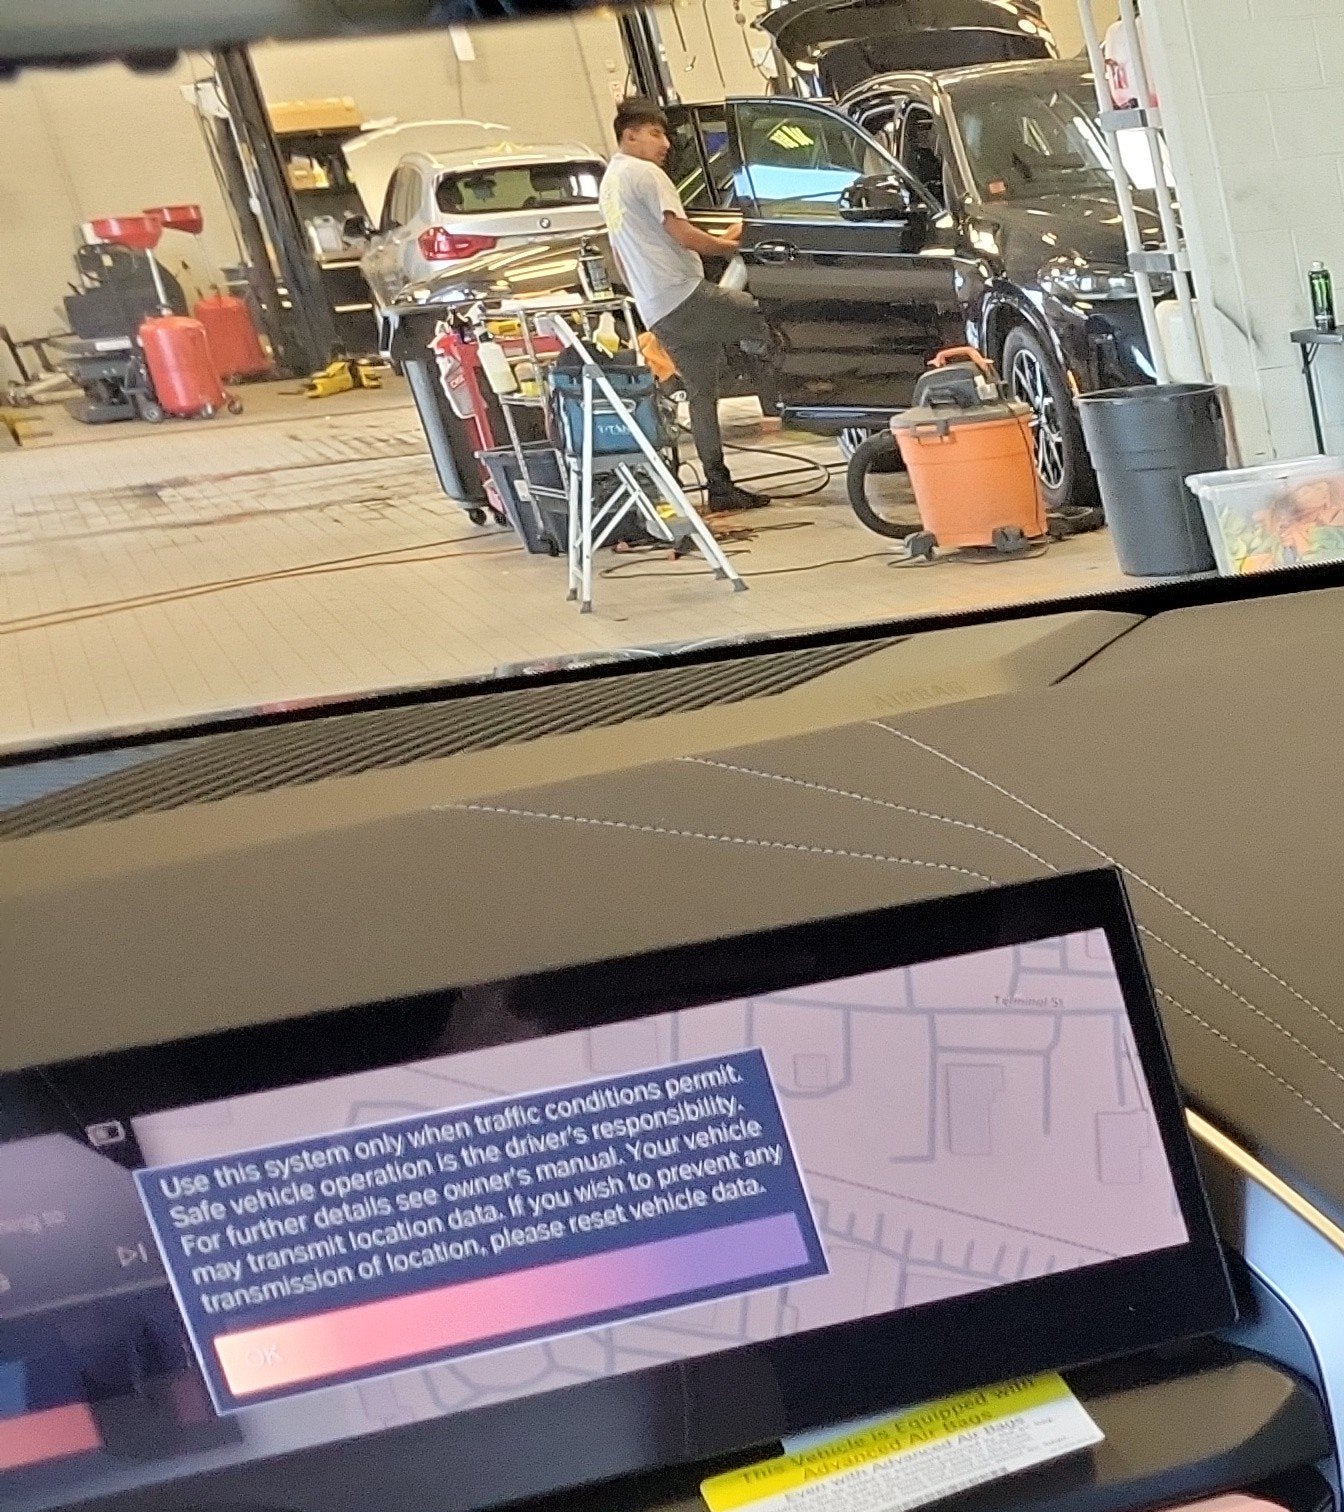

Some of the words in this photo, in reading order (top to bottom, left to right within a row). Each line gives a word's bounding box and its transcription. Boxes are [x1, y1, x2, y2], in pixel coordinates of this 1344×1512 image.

[160, 1172, 210, 1200] Use
[214, 1162, 261, 1189] this
[264, 1145, 349, 1181] system
[354, 1131, 402, 1159] only
[408, 1116, 471, 1146] when
[474, 1103, 541, 1136] traffic
[545, 1081, 661, 1122] conditions
[665, 1063, 743, 1099] permit.
[169, 1199, 227, 1229] Safe
[231, 1180, 316, 1214] vehicle
[320, 1158, 433, 1199] operation
[438, 1151, 457, 1172] is
[461, 1142, 501, 1168] the
[505, 1126, 589, 1160] driver's
[592, 1095, 746, 1140] responsibility.
[180, 1231, 222, 1257] For
[226, 1212, 309, 1248] further
[314, 1194, 392, 1229] details
[396, 1190, 438, 1212] see
[443, 1164, 533, 1202] owner's
[536, 1146, 627, 1182] manual.
[626, 1134, 681, 1162] Your
[684, 1118, 763, 1149] vehicle
[192, 1258, 243, 1287] may
[247, 1235, 347, 1274] transmit
[349, 1210, 445, 1246] location
[447, 1202, 505, 1231] data.
[508, 1192, 525, 1217] If
[528, 1189, 571, 1219] you
[574, 1173, 626, 1205] wish
[627, 1172, 651, 1191] to
[656, 1150, 742, 1190] prevent
[743, 1141, 784, 1167] any
[201, 1265, 354, 1315] transmission
[358, 1255, 382, 1281] of
[386, 1237, 487, 1273] location,
[489, 1219, 566, 1255] please
[569, 1202, 627, 1232] reset
[629, 1185, 709, 1221] vehicle
[711, 1175, 767, 1205] data.
[247, 1342, 284, 1368] OK
[743, 1464, 786, 1484] This
[790, 1436, 865, 1466] Vehicle
[871, 1429, 889, 1442] is
[894, 1392, 989, 1432] Equipped
[993, 1376, 1036, 1400] with
[785, 1483, 826, 1502] Even
[832, 1469, 868, 1486] with
[871, 1440, 952, 1473] Advanced
[957, 1431, 980, 1445] Air
[983, 1416, 1026, 1433] Bags
[803, 1439, 901, 1482] Advanced
[908, 1428, 934, 1445] Air
[942, 1410, 993, 1431] Bags
